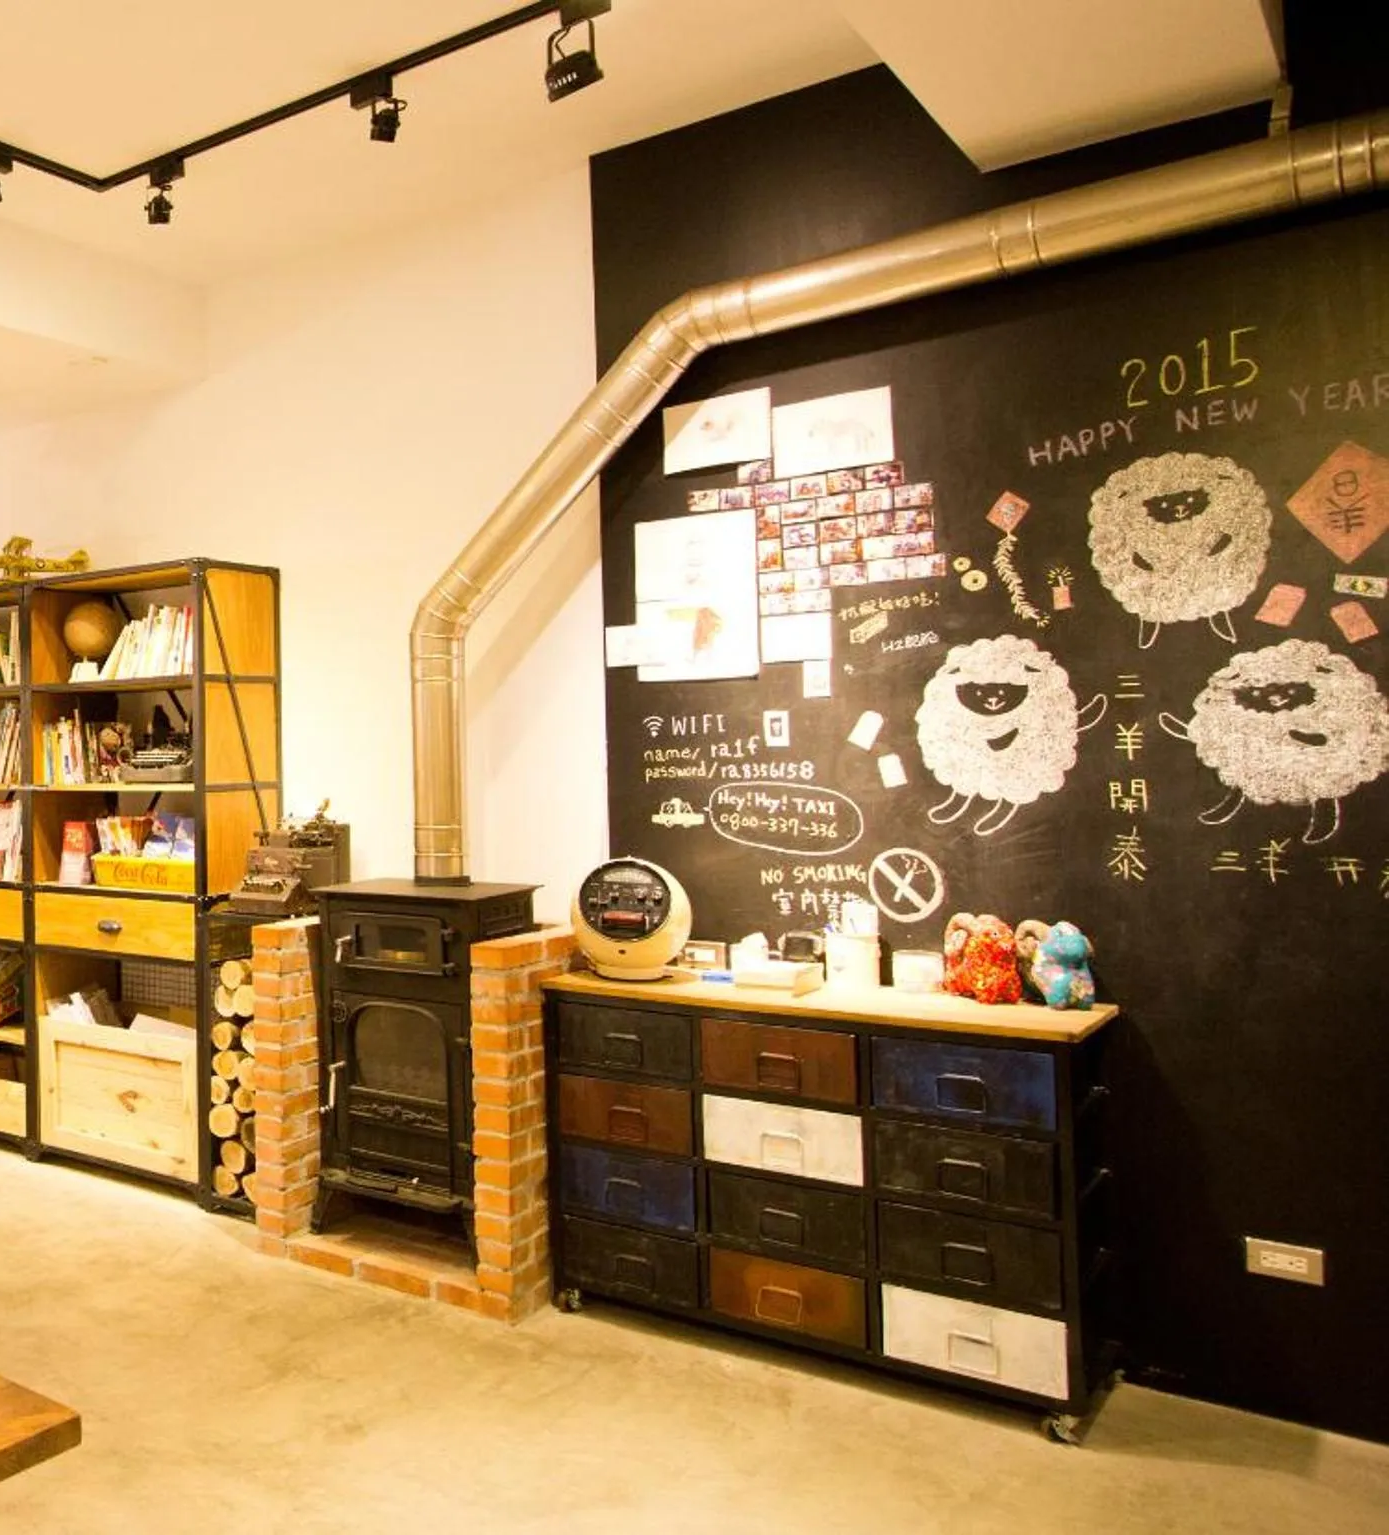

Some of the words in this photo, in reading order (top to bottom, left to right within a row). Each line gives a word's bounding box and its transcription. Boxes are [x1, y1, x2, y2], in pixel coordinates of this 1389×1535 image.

[1120, 326, 1259, 408] 2015
[1028, 414, 1140, 468] HAPPY
[1174, 398, 1259, 433] NEW
[1288, 373, 1389, 416] YEAR
[671, 714, 727, 737] WIFI
[791, 797, 837, 816] TAXI
[720, 812, 839, 838] 0800-337-336
[761, 867, 784, 885] NO
[792, 863, 868, 885] SMOKING
